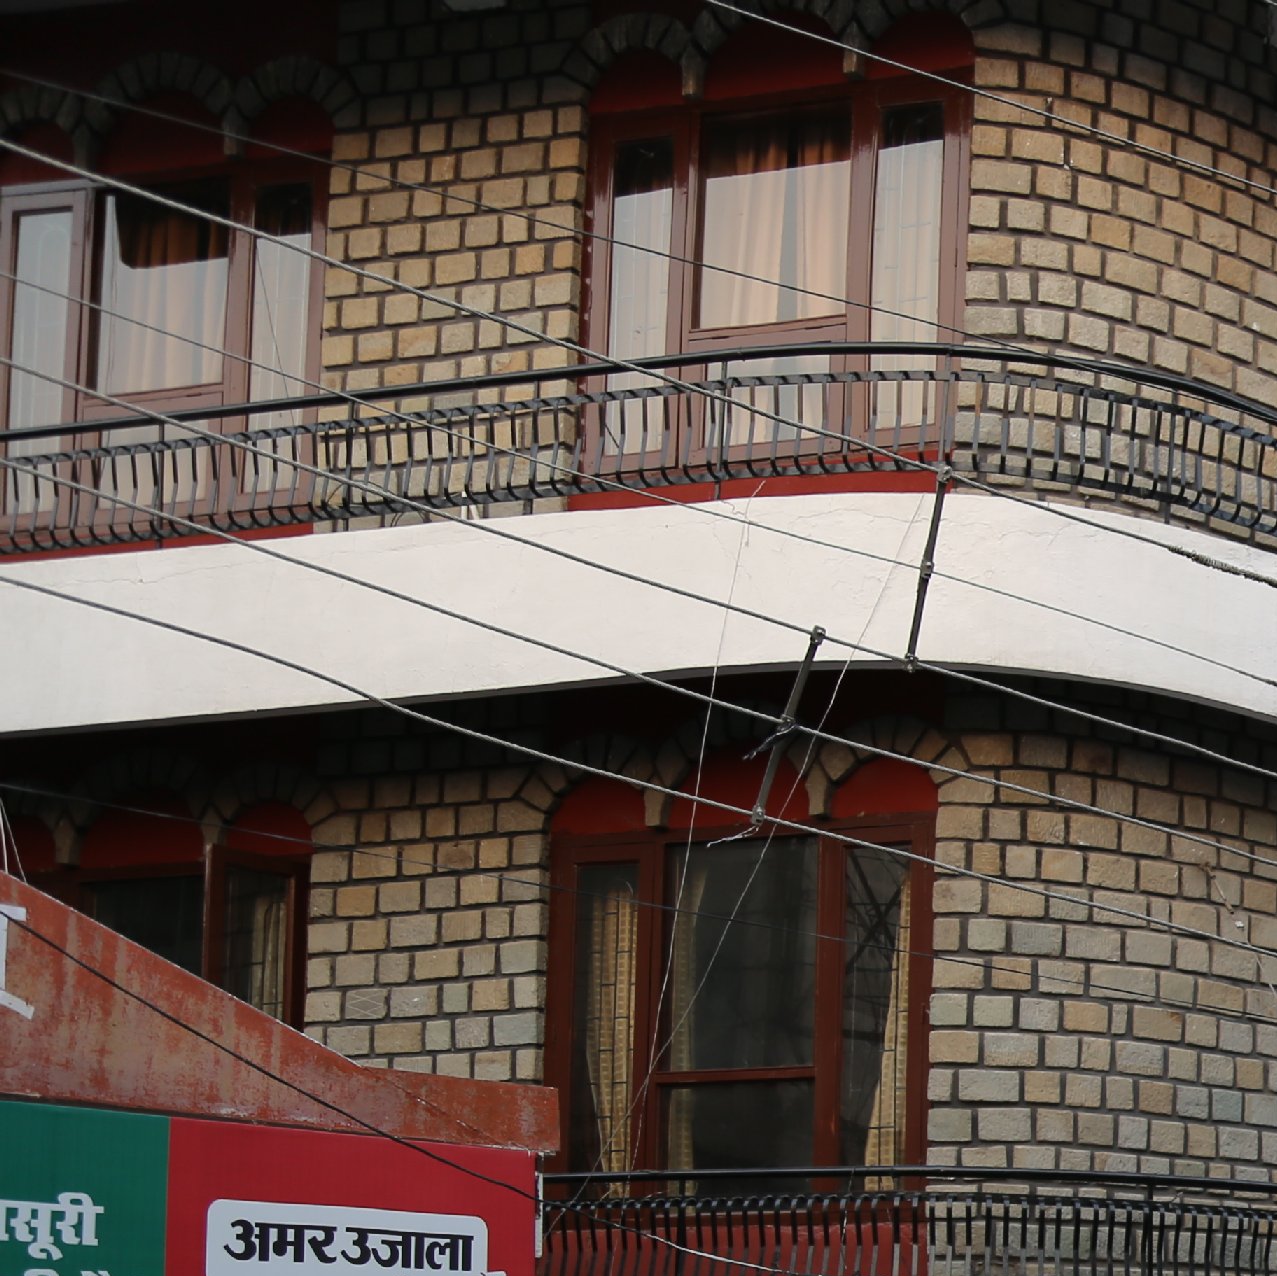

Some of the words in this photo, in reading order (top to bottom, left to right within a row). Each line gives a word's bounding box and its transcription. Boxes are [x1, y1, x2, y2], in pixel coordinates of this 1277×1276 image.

[0, 1192, 104, 1261] सूरी
[223, 1219, 337, 1263] अमर
[340, 1226, 474, 1272] उजाला
